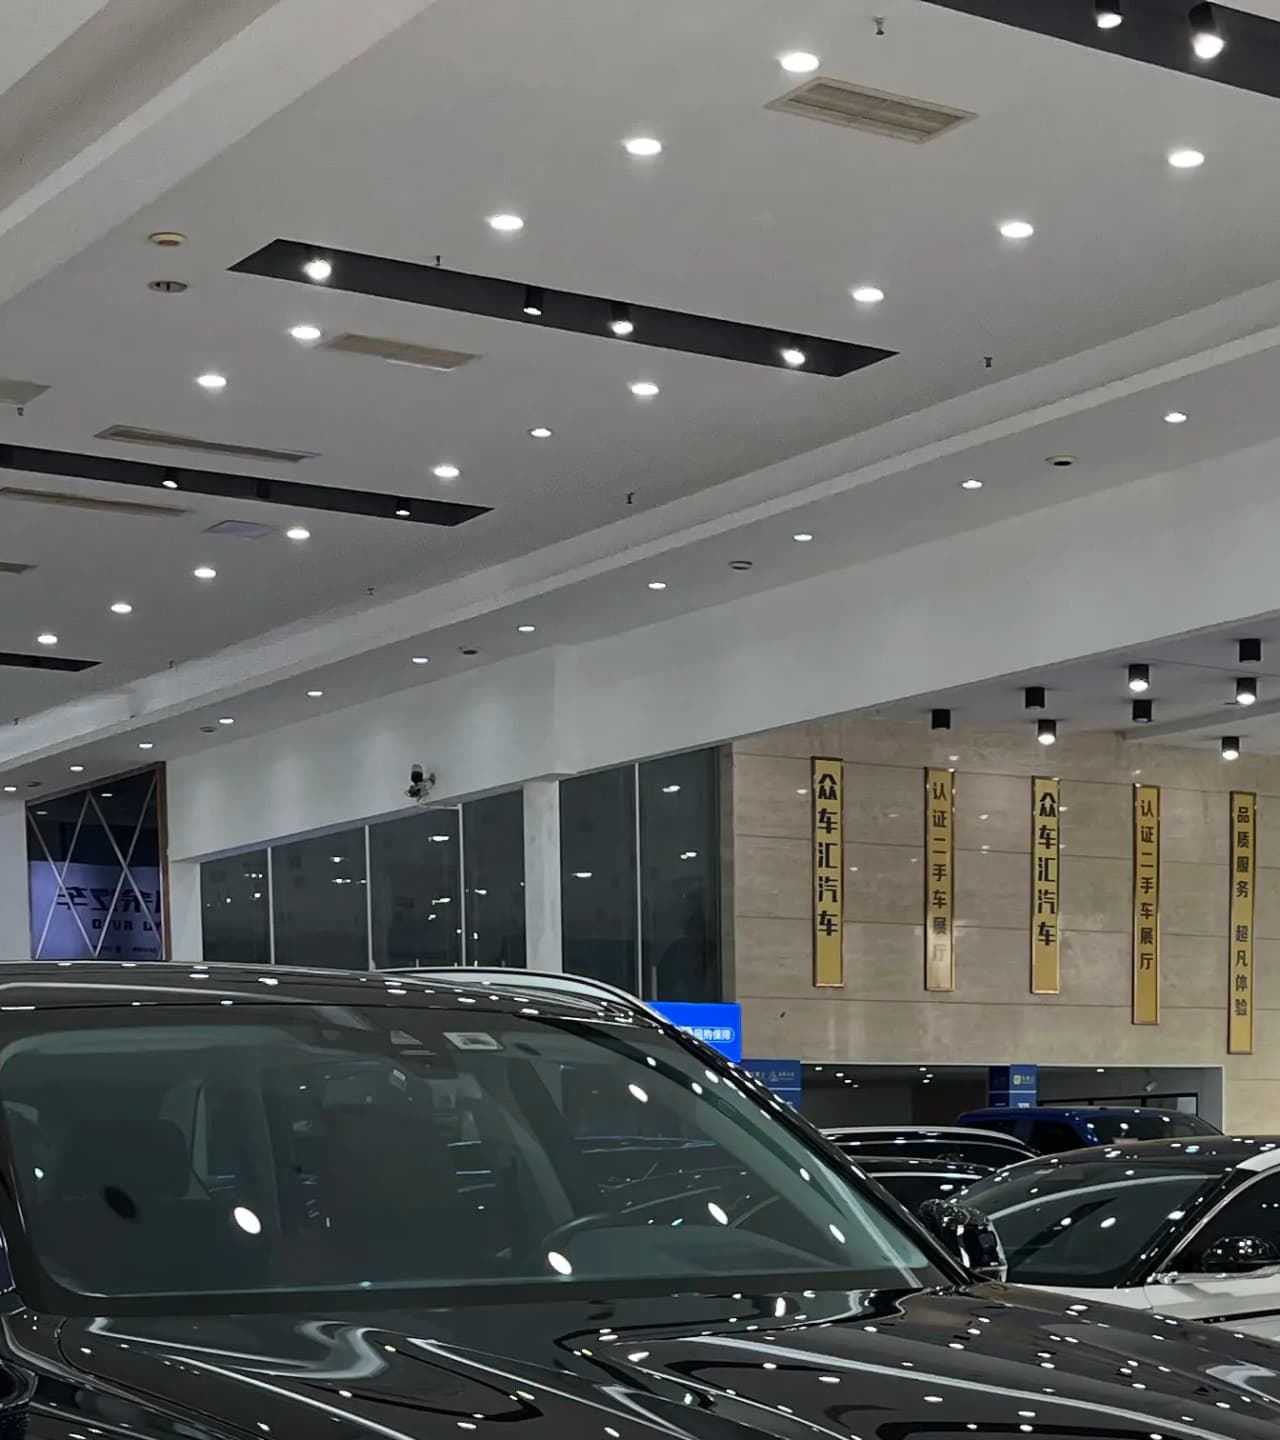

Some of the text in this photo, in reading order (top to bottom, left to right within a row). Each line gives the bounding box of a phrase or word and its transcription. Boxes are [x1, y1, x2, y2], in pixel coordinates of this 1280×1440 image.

[817, 773, 839, 936] 众车汇汽车
[932, 782, 948, 962] 认证二手车展厅
[1037, 791, 1057, 946] 众车汇汽车
[1139, 800, 1155, 970] 认证二手车展厅
[1235, 806, 1250, 1016] 品质服务 超凡体验
